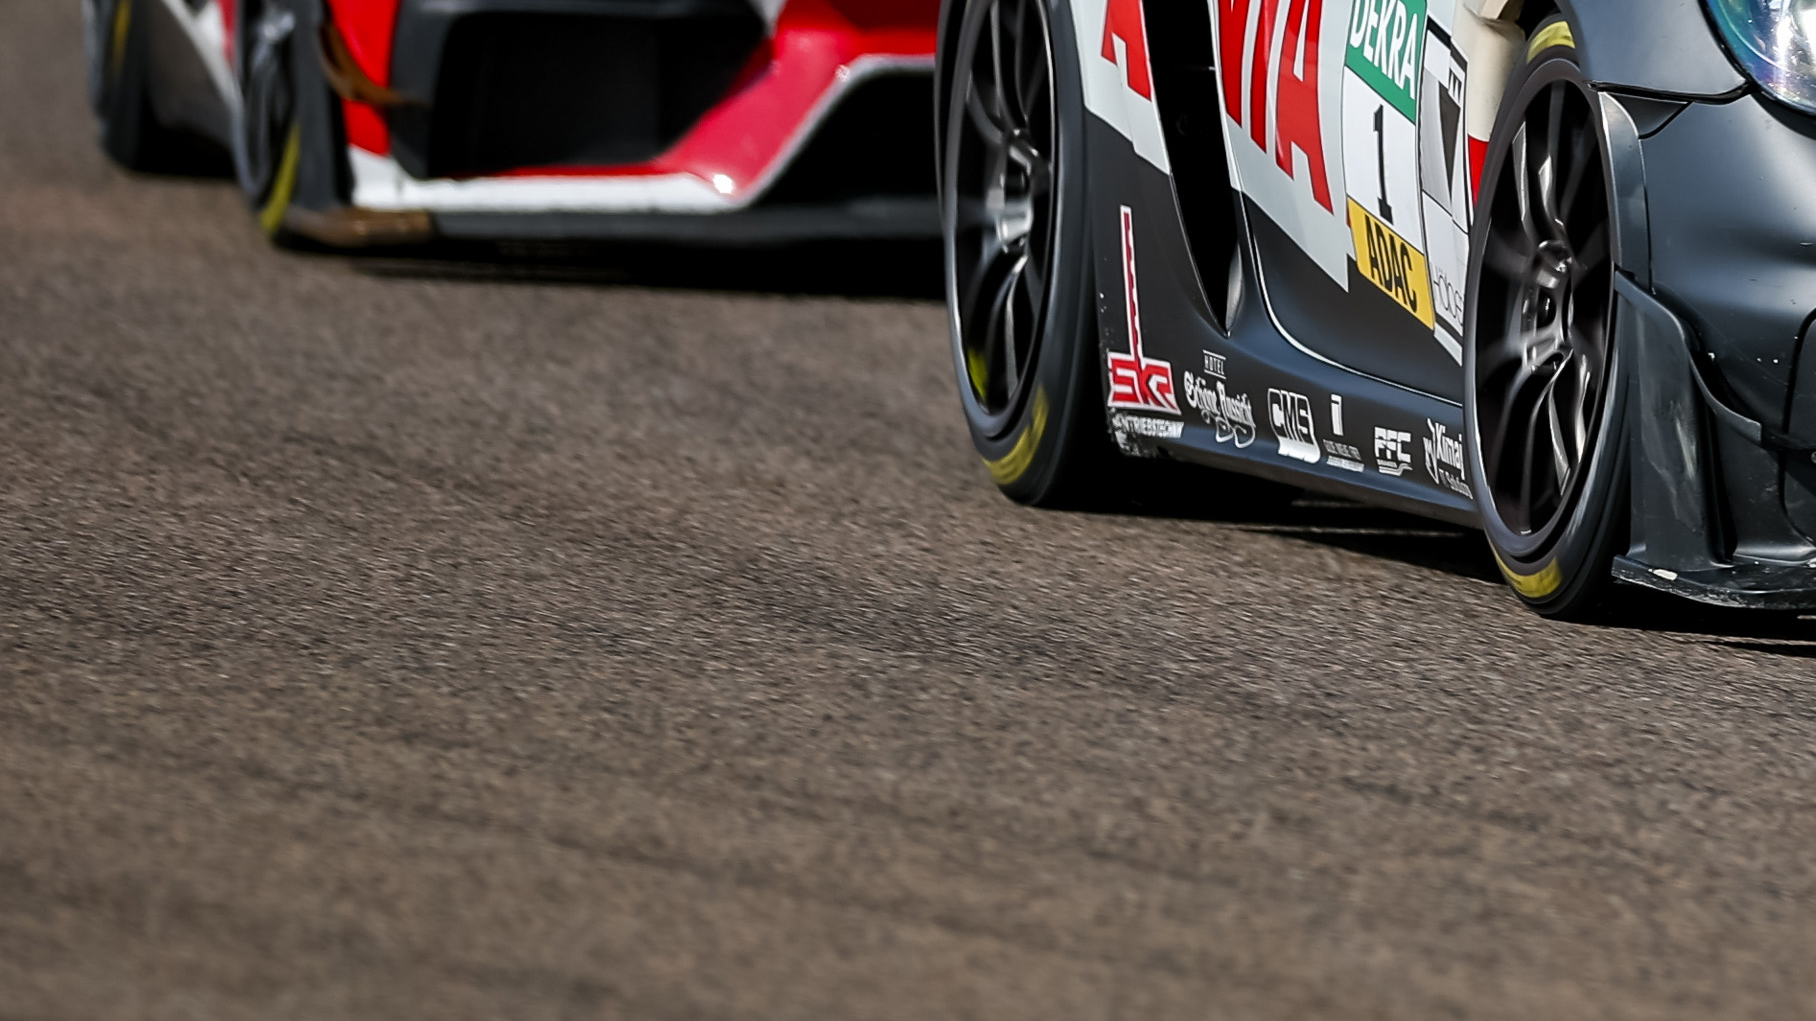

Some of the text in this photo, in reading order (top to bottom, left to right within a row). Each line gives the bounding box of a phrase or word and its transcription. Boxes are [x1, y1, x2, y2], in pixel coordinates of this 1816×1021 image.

[1371, 103, 1394, 224] 1
[1363, 213, 1419, 313] ADAC
[1204, 354, 1226, 376] HOTEL
[1375, 426, 1412, 464] PFC
